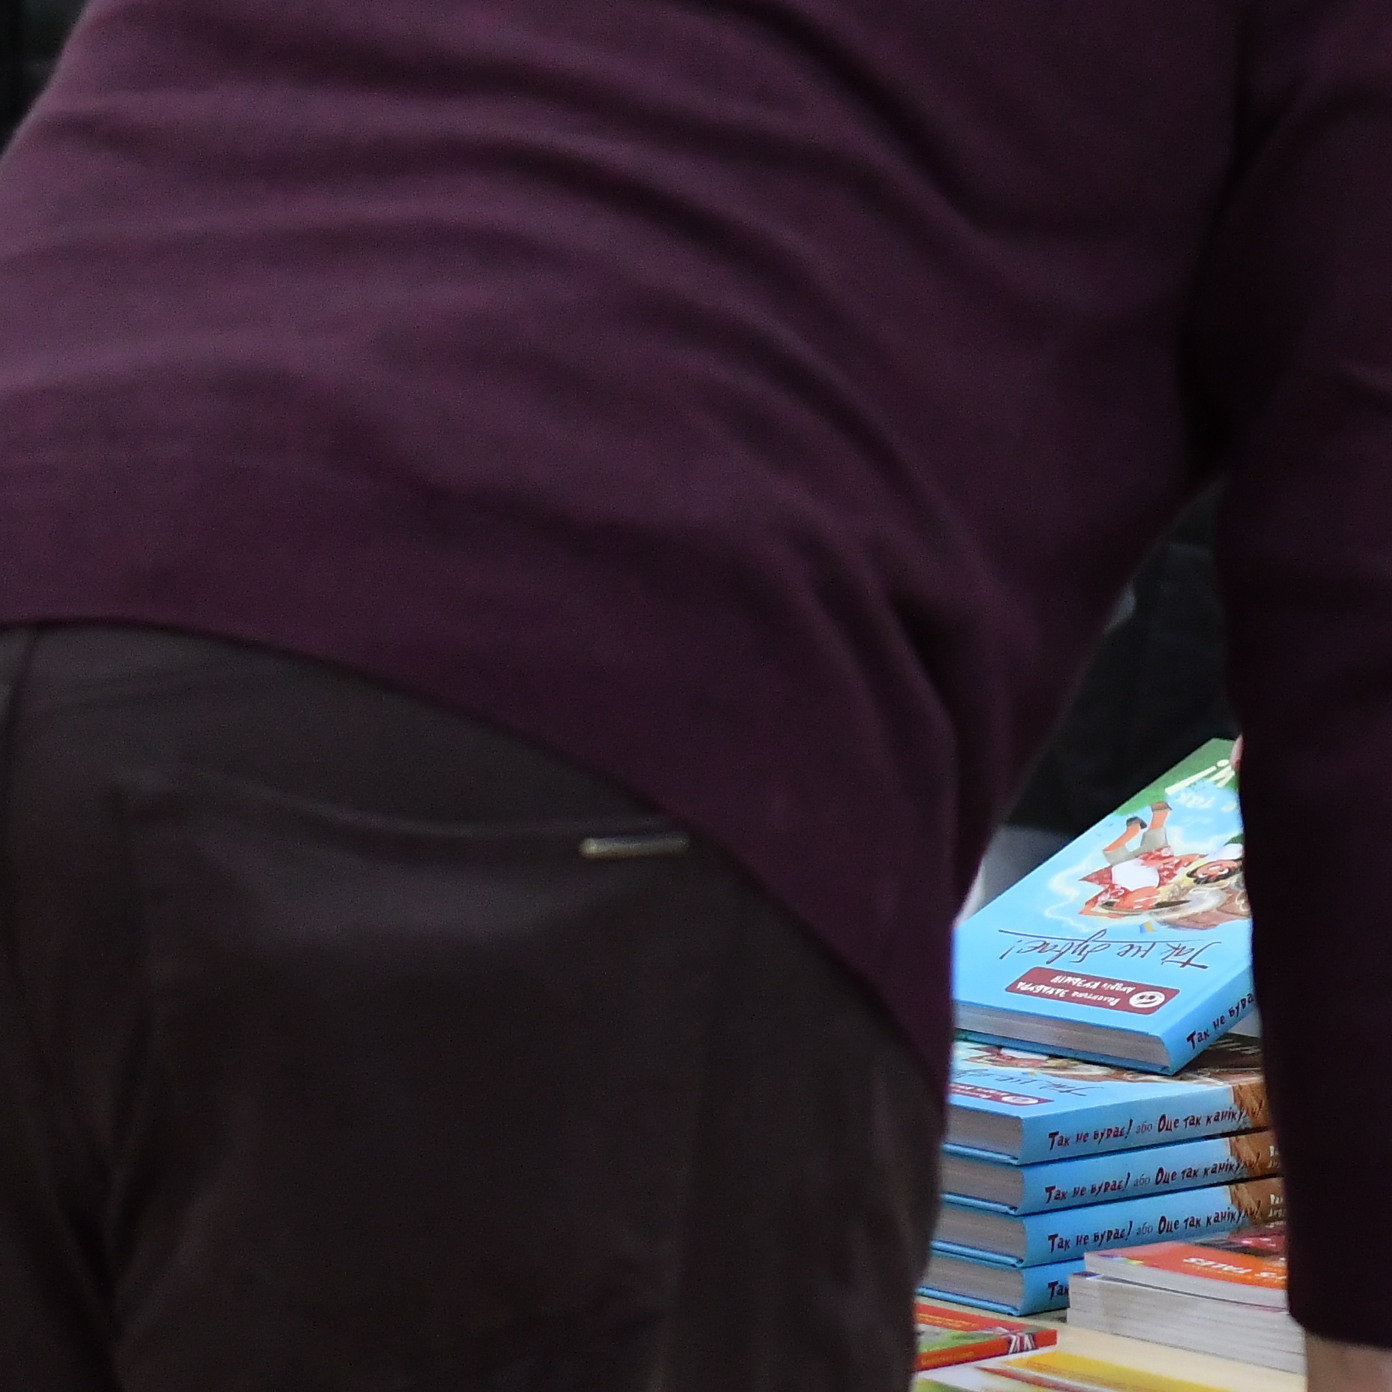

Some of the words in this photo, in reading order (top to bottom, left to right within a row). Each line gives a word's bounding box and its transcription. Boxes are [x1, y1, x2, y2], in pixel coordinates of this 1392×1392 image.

[1117, 942, 1156, 959] не
[1161, 941, 1222, 969] Так
[1187, 1029, 1210, 1049] Так
[1048, 1131, 1070, 1150] Так
[1076, 1132, 1089, 1143] не
[1158, 1114, 1180, 1133] Оце
[1183, 1116, 1201, 1128] так
[1045, 1185, 1067, 1204] Так
[1073, 1186, 1086, 1197] не
[1155, 1167, 1177, 1186] Оце
[1181, 1167, 1198, 1180] так
[1048, 1234, 1070, 1253] Так
[1076, 1235, 1089, 1246] не
[1158, 1216, 1180, 1235] Оце
[1183, 1216, 1201, 1230] так
